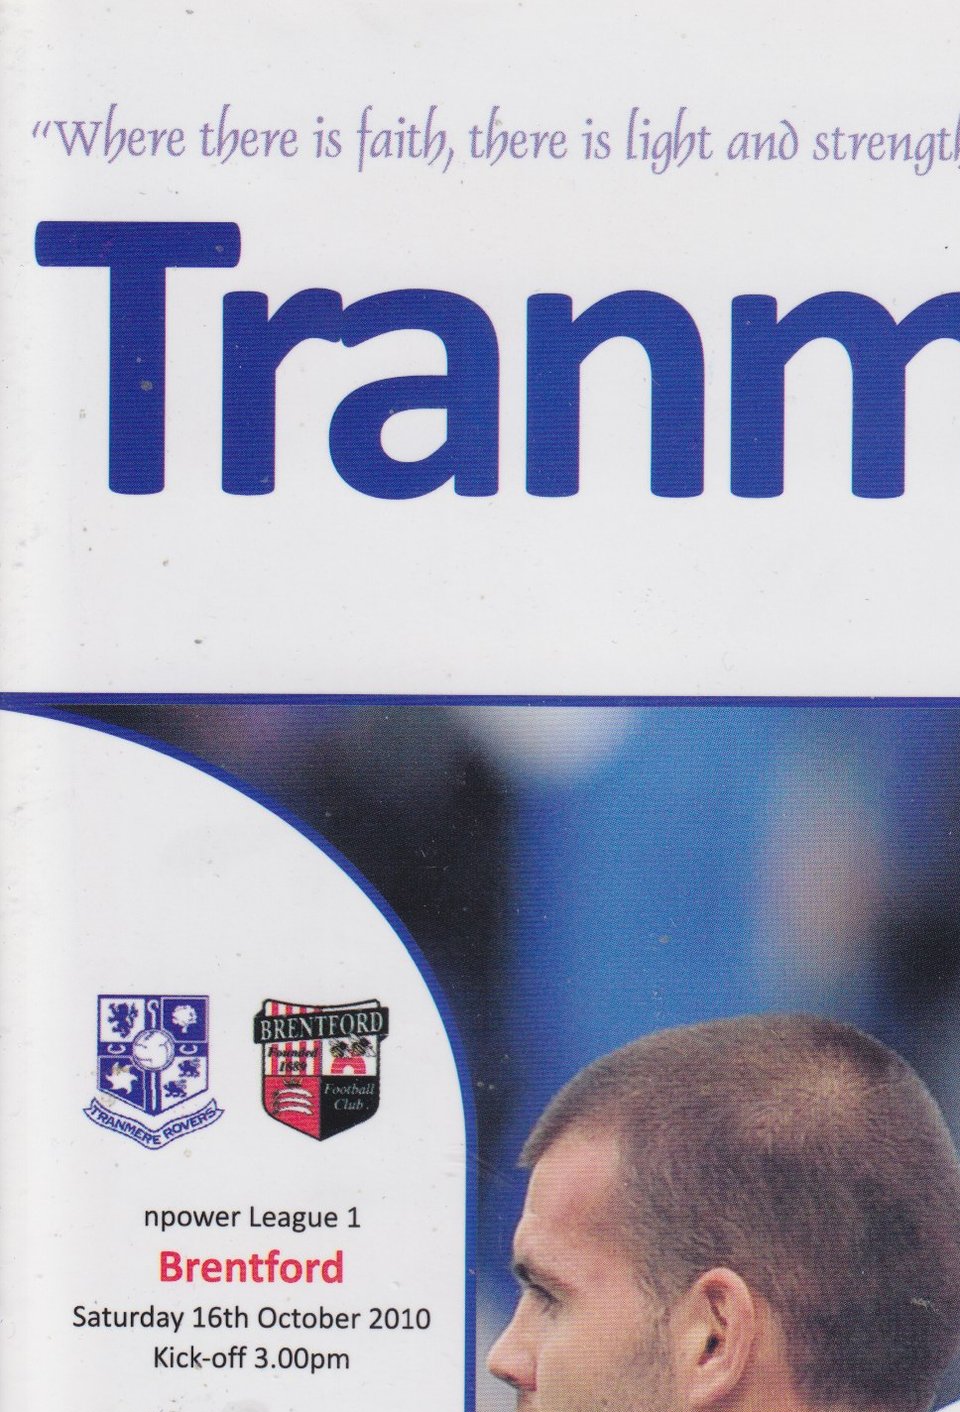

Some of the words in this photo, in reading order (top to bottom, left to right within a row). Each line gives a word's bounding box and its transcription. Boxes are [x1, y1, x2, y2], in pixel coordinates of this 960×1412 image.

[199, 103, 299, 164] there
[313, 115, 343, 158] is
[356, 104, 455, 174] faith,
[468, 105, 568, 167] there
[581, 117, 611, 161] is
[624, 106, 714, 175] light
[726, 119, 799, 161] and
[260, 1011, 384, 1041] BRENTFORD
[323, 1082, 376, 1096] Football
[90, 1104, 161, 1145] TRANMERE
[162, 1107, 216, 1139] ROVERS
[144, 1208, 241, 1232] npower
[249, 1206, 338, 1233] League
[347, 1206, 361, 1229] 1
[159, 1249, 344, 1284] Brentford
[72, 1305, 184, 1333] Saturday
[192, 1306, 249, 1329] 16th
[257, 1306, 361, 1330] October
[368, 1307, 431, 1330] 2010
[153, 1346, 248, 1370] Kick-off
[254, 1347, 350, 1374] 3.00pm
